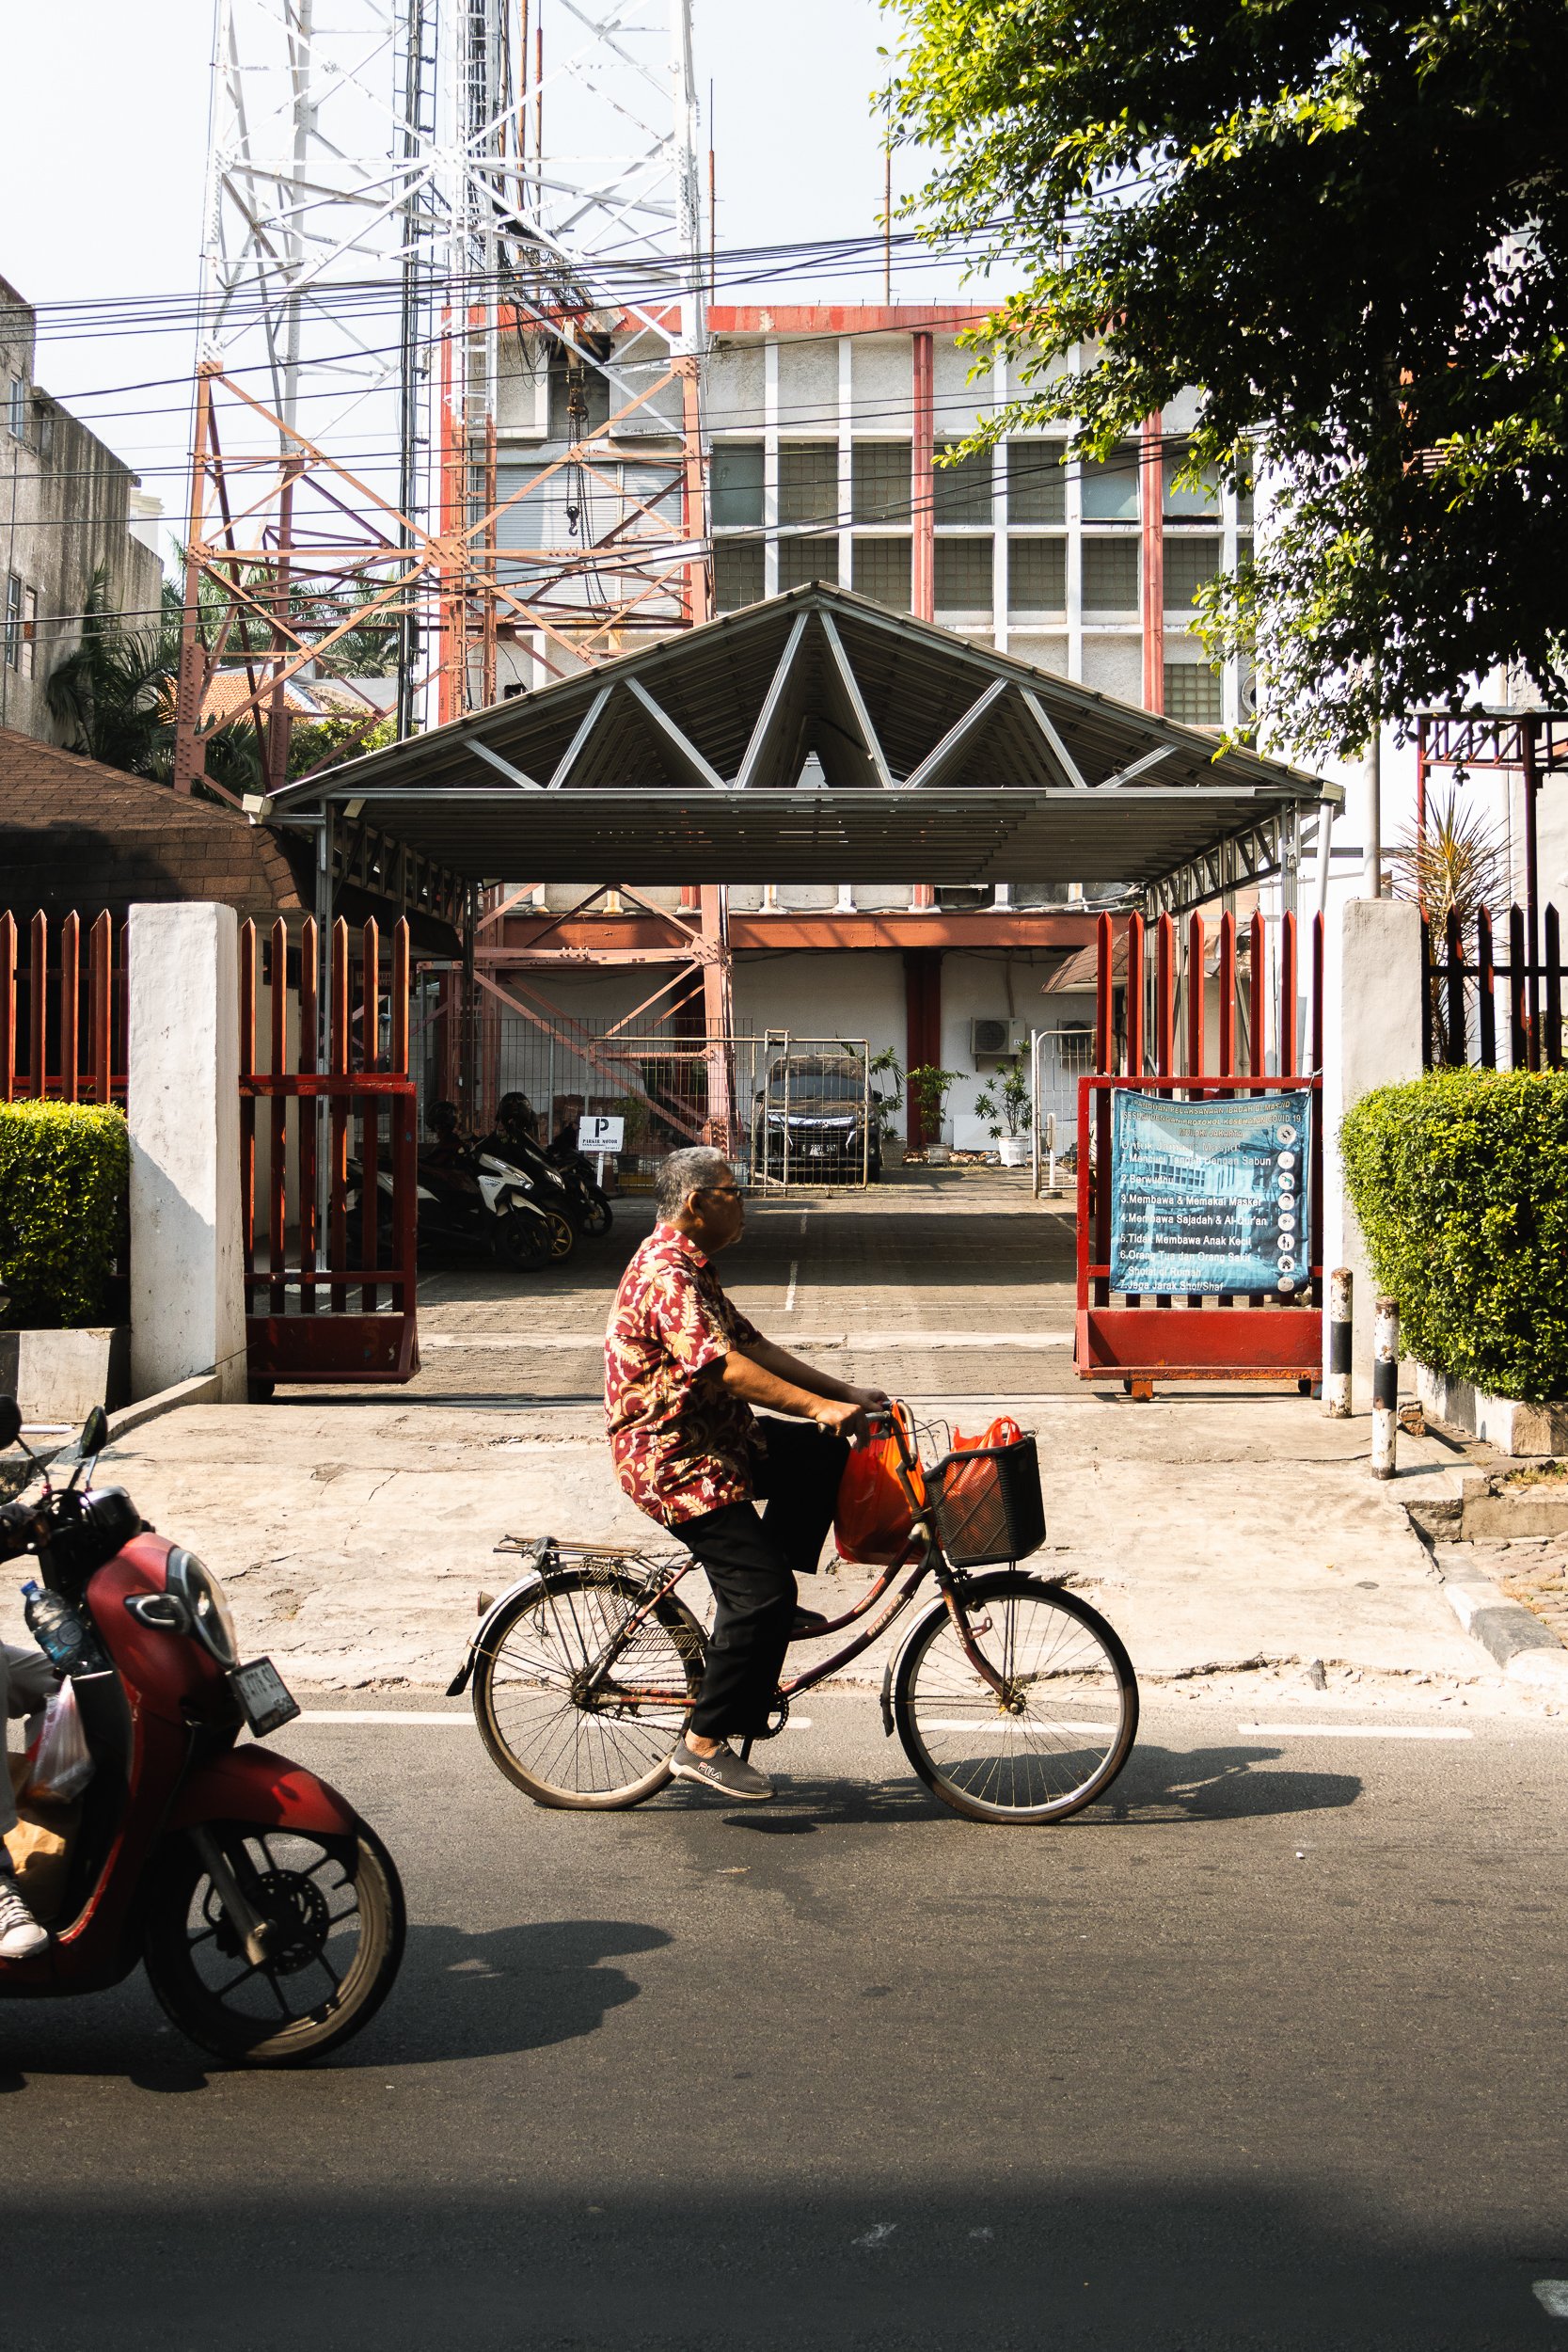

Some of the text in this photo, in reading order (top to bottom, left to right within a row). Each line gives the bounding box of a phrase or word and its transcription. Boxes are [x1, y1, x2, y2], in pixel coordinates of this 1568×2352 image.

[1226, 1105, 1253, 1114] IBADAH
[1264, 1101, 1291, 1111] MASJID
[1223, 1117, 1267, 1125] KESEHATAN
[1267, 1114, 1291, 1124] COVID
[1292, 1114, 1301, 1123] 19
[594, 1118, 610, 1137] P
[1209, 1129, 1243, 1138] JAKARTA
[1242, 1156, 1272, 1167] Sabun
[1120, 1194, 1261, 1207] 3.Membawa & Memakai Masker
[1176, 1215, 1213, 1227] Sajadah
[1215, 1216, 1222, 1225] &
[1156, 1234, 1200, 1245] Membawa
[1203, 1235, 1227, 1246] Anak
[1228, 1236, 1252, 1247] Kecil
[1158, 1252, 1175, 1261] Tua
[1178, 1252, 1195, 1262] dan
[1197, 1252, 1226, 1263] Orang
[1228, 1252, 1252, 1263] Sakit
[1160, 1266, 1167, 1277] di
[1170, 1266, 1201, 1277] Rumah
[1151, 1280, 1177, 1290] Jarak
[698, 1762, 721, 1780] FILA
